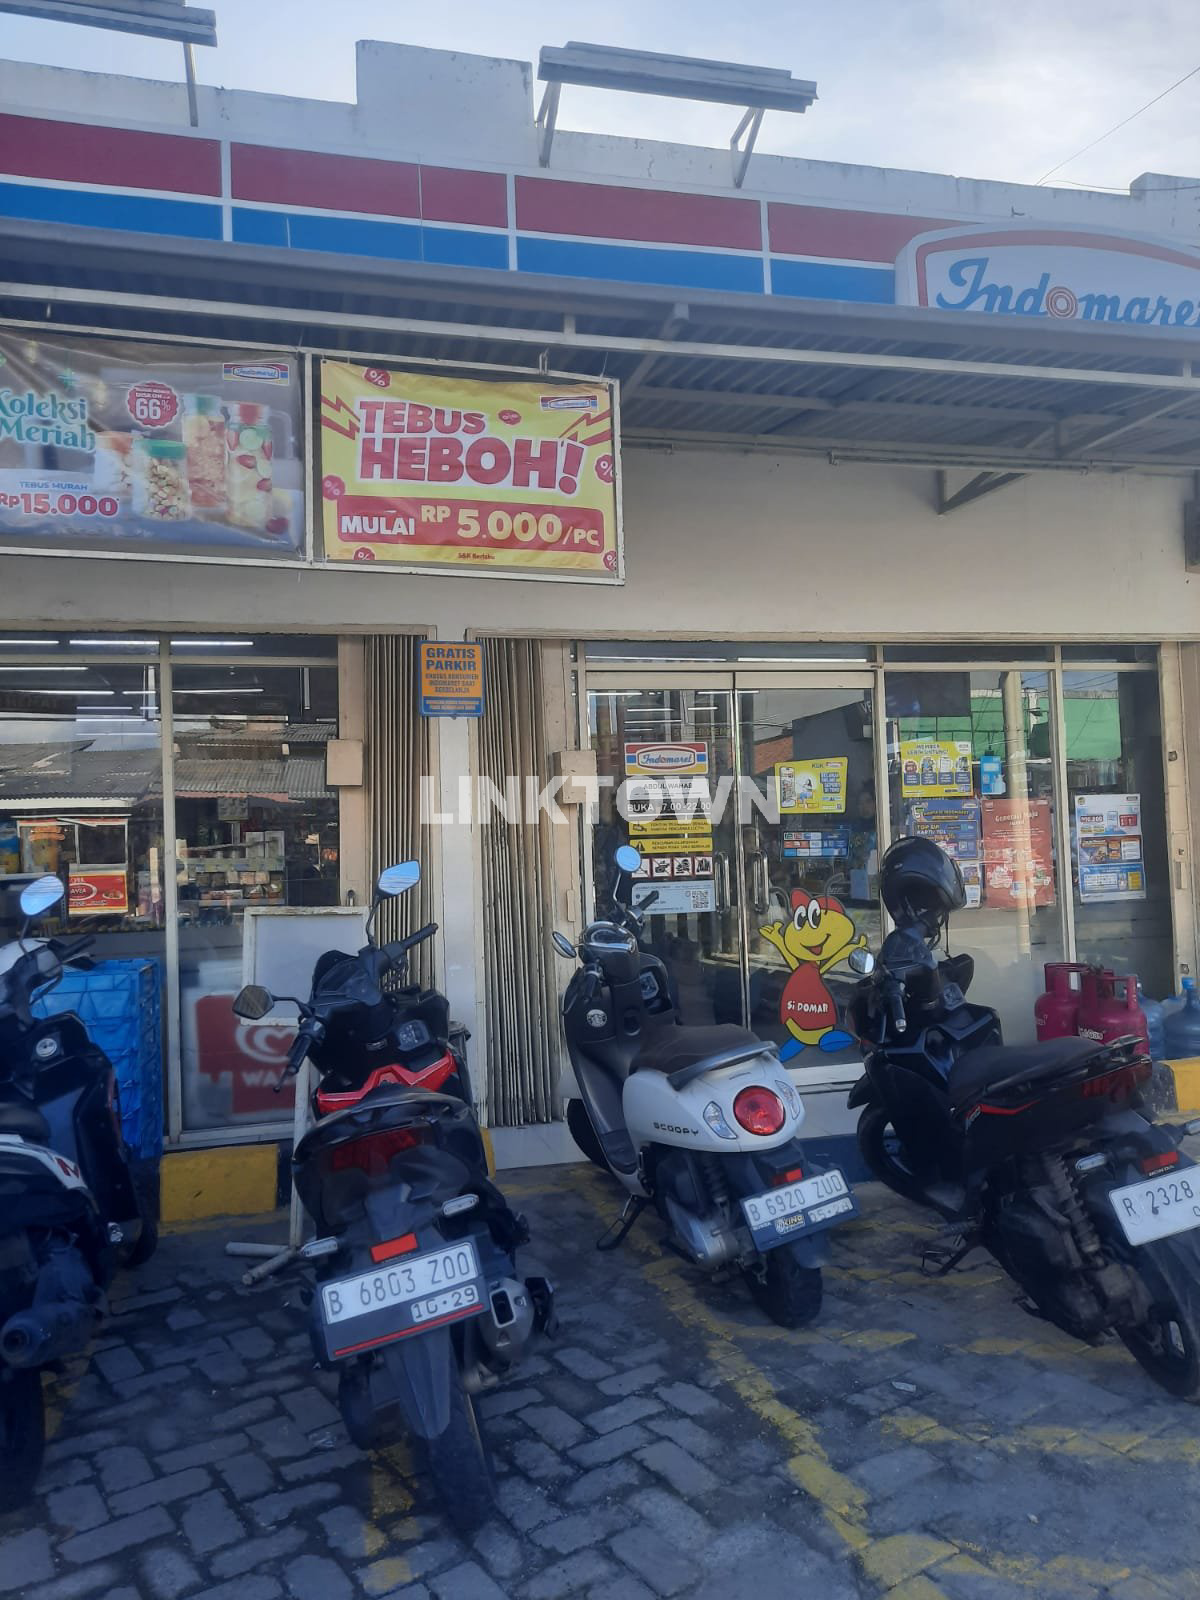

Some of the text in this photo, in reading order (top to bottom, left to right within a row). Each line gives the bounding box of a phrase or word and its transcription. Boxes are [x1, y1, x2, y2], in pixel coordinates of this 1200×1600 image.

[936, 257, 1200, 328] Indomare
[359, 401, 487, 435] TEBUS
[0, 417, 95, 451] Meriah
[360, 437, 585, 495] HEBOH!
[52, 482, 88, 491] MURAH
[341, 516, 415, 535] MULAI
[421, 504, 451, 523] RP
[426, 648, 476, 659] GRATIS
[426, 660, 477, 671] PARKIR
[641, 754, 692, 765] Indomaret
[627, 803, 655, 812] BUKA
[797, 1002, 829, 1013] DOMAR
[653, 1122, 699, 1136] SCOOPY
[749, 1203, 760, 1221] B
[768, 1189, 806, 1214] 6920
[1123, 1198, 1137, 1217] R
[1146, 1180, 1194, 1211] 2328
[328, 1290, 343, 1316] B
[360, 1268, 417, 1305] 6803
